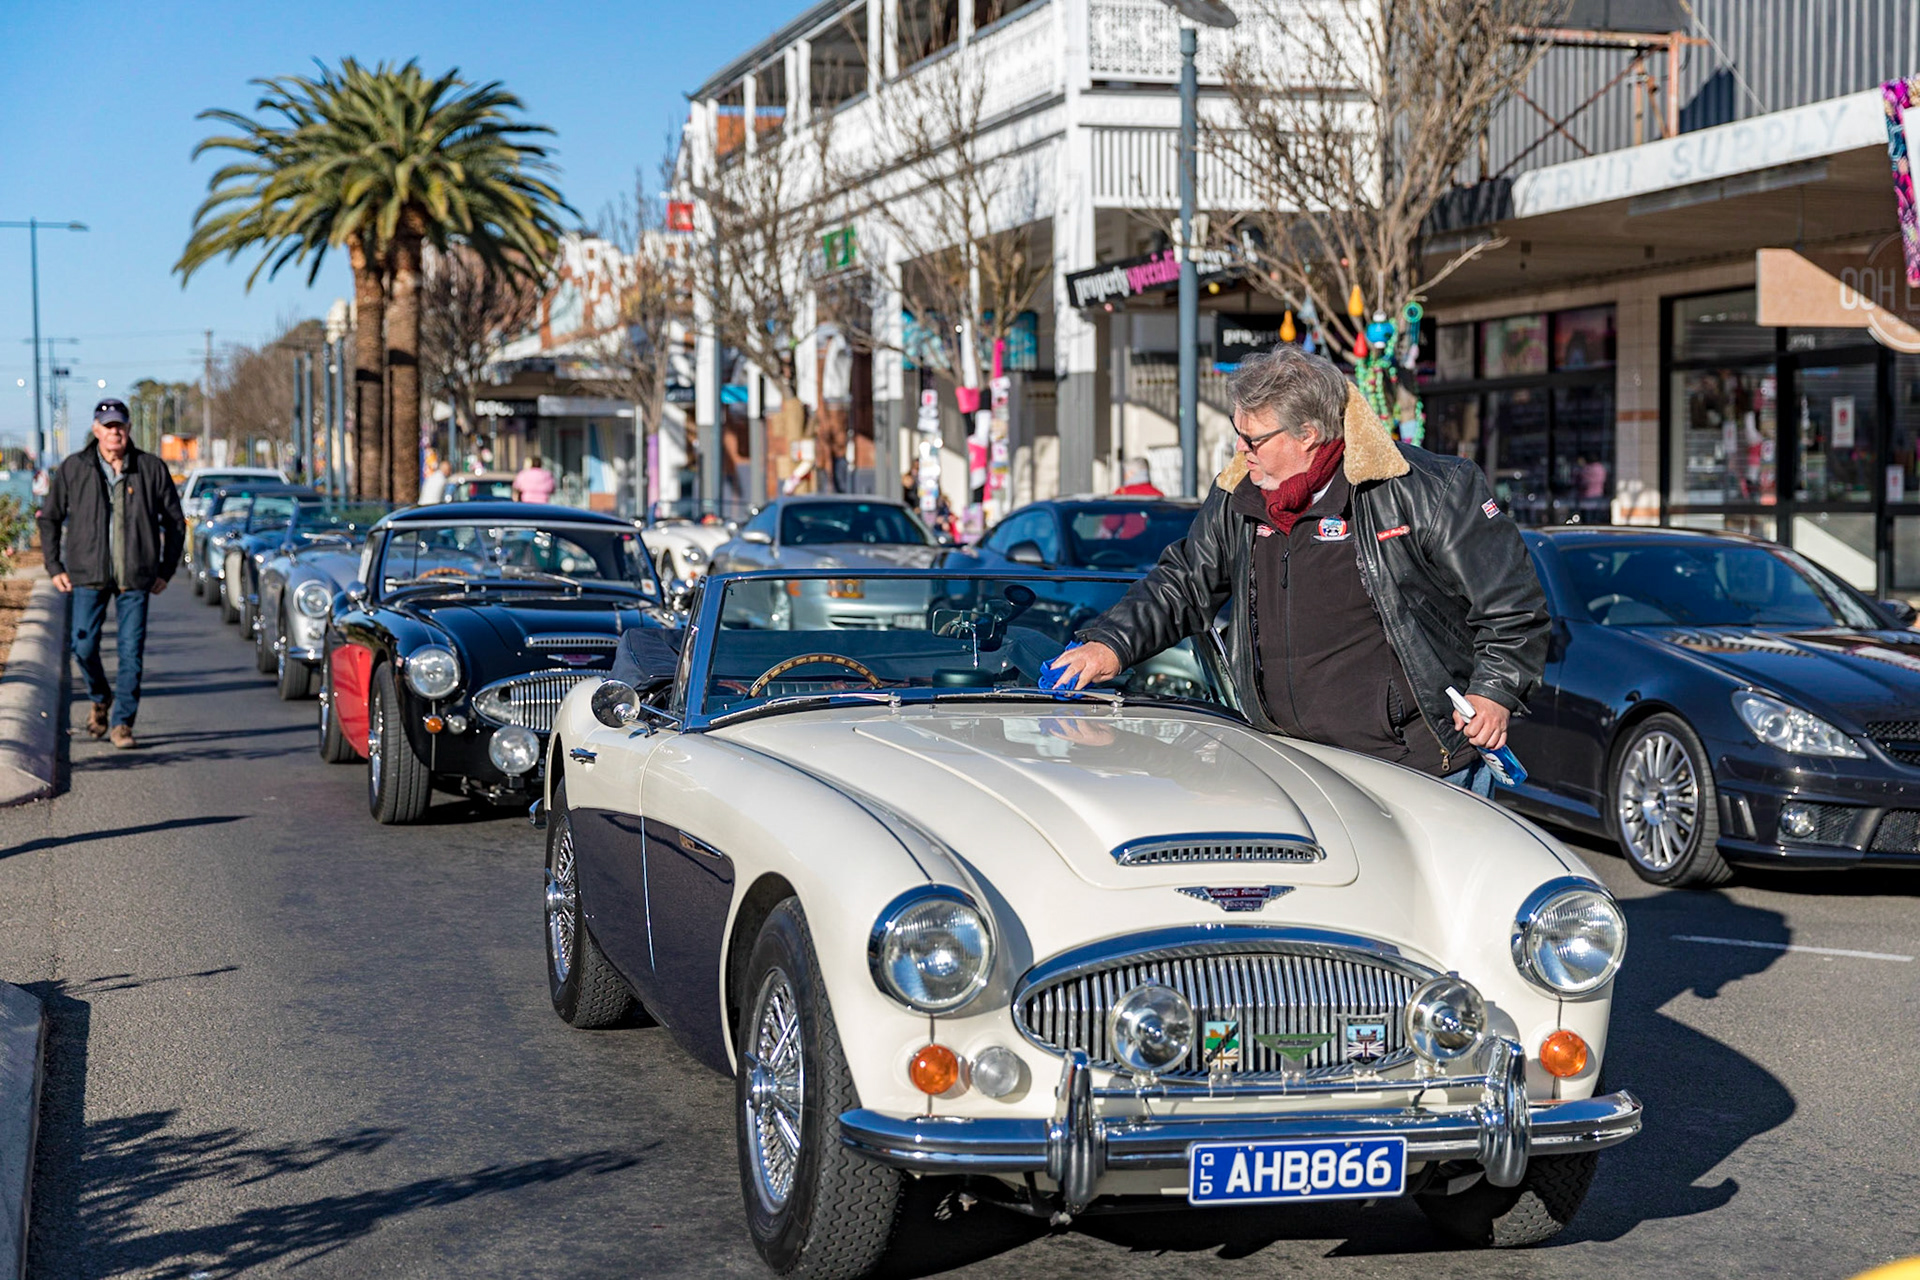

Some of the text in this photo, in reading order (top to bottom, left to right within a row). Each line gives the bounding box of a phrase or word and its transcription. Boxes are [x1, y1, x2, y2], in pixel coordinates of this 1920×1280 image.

[1526, 103, 1849, 207] FRUIT SUPPLY
[1839, 266, 1896, 311] OOH
[1199, 1146, 1392, 1195] QLD AHB866
